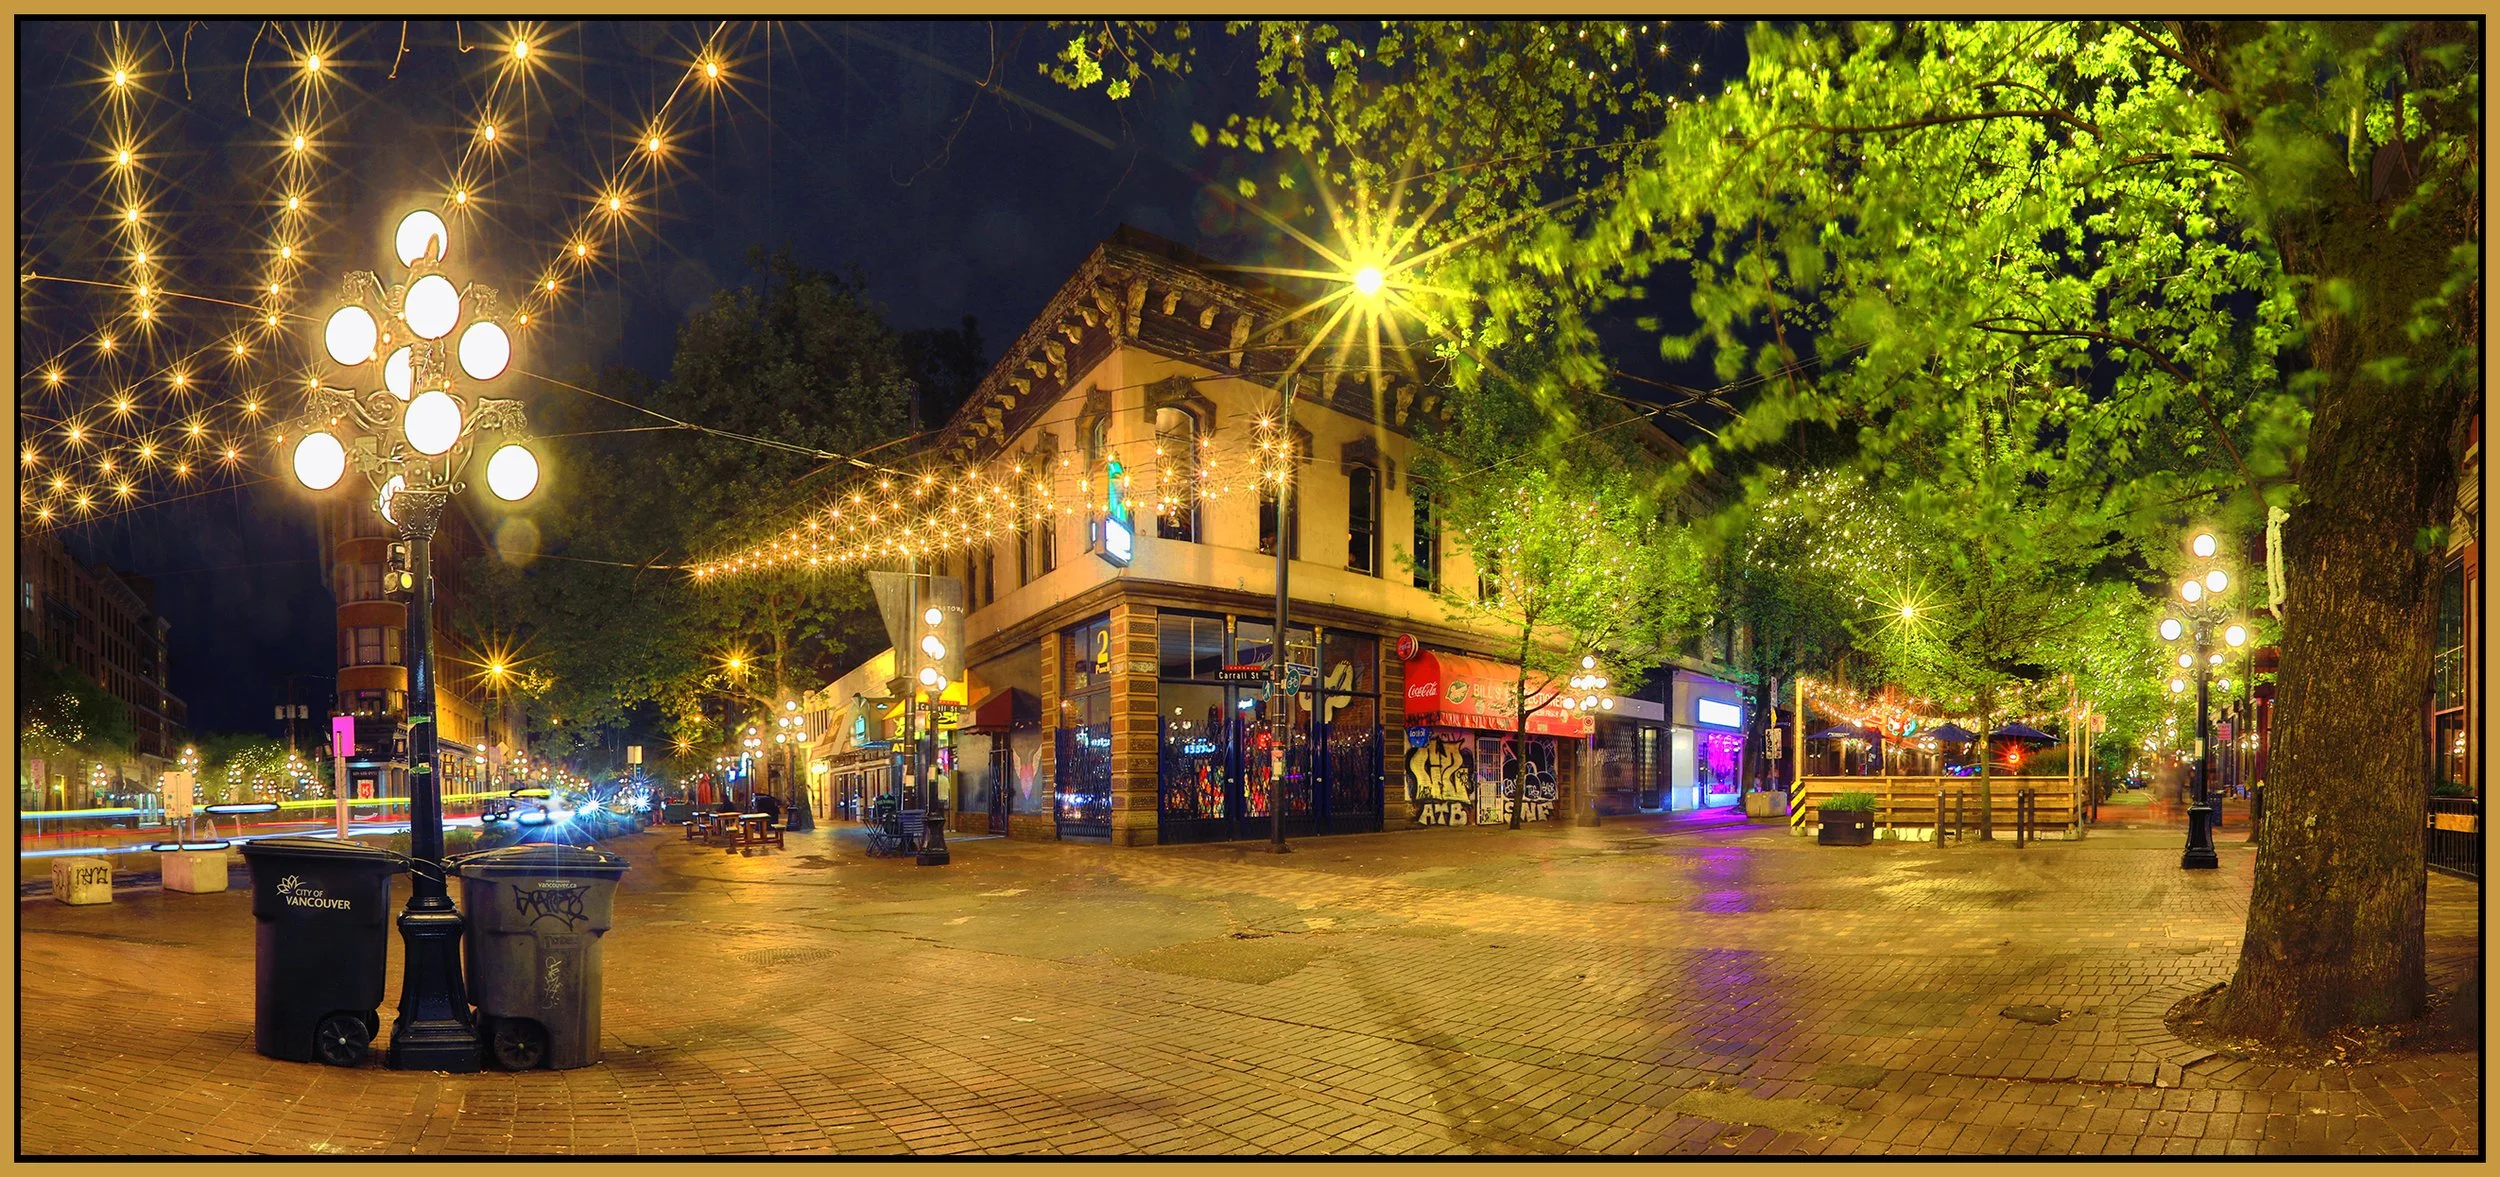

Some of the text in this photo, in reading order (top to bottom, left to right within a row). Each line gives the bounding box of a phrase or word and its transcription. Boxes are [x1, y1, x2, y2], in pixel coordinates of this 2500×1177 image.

[1097, 630, 1109, 664] 2
[1218, 671, 1247, 680] Carrall
[1250, 671, 1260, 680] St
[892, 743, 917, 753] AT
[1418, 801, 1468, 827] ATB
[295, 888, 324, 898] CITY OF
[286, 896, 351, 910] VANCOUVER
